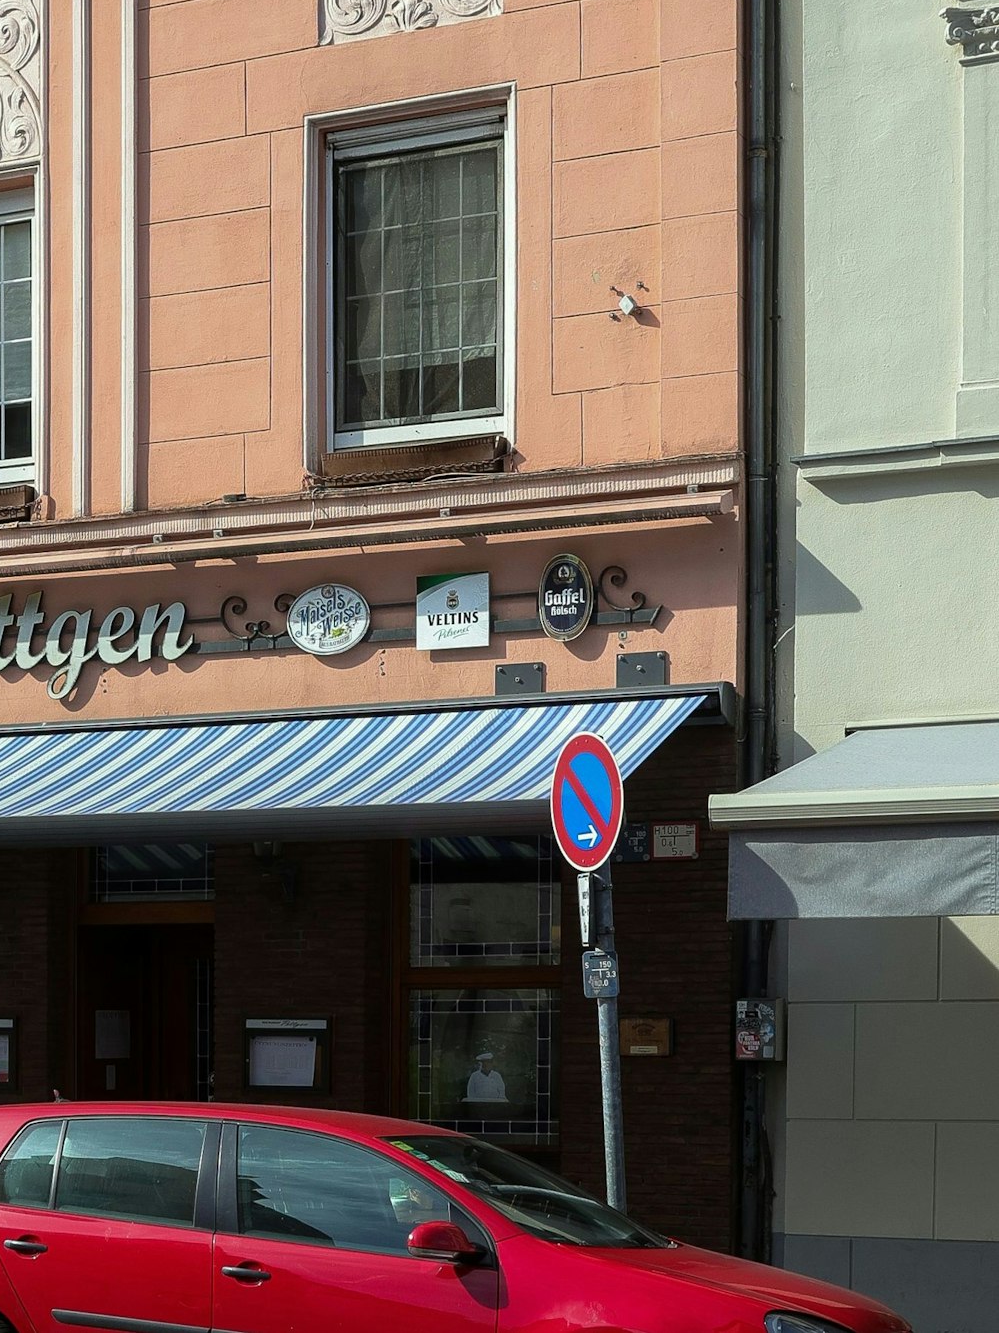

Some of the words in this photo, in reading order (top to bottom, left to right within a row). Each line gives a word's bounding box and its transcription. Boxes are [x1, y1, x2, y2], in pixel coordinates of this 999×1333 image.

[544, 587, 586, 607] Gaffel
[295, 587, 346, 638] Maisel's
[427, 609, 479, 626] VELTINS
[550, 605, 578, 617] Kölsch
[316, 601, 361, 638] Weisse
[433, 625, 471, 641] Pilsener
[671, 847, 683, 856] 5.0
[584, 961, 589, 969] S
[599, 960, 612, 968] 150
[605, 970, 617, 978] 3.3
